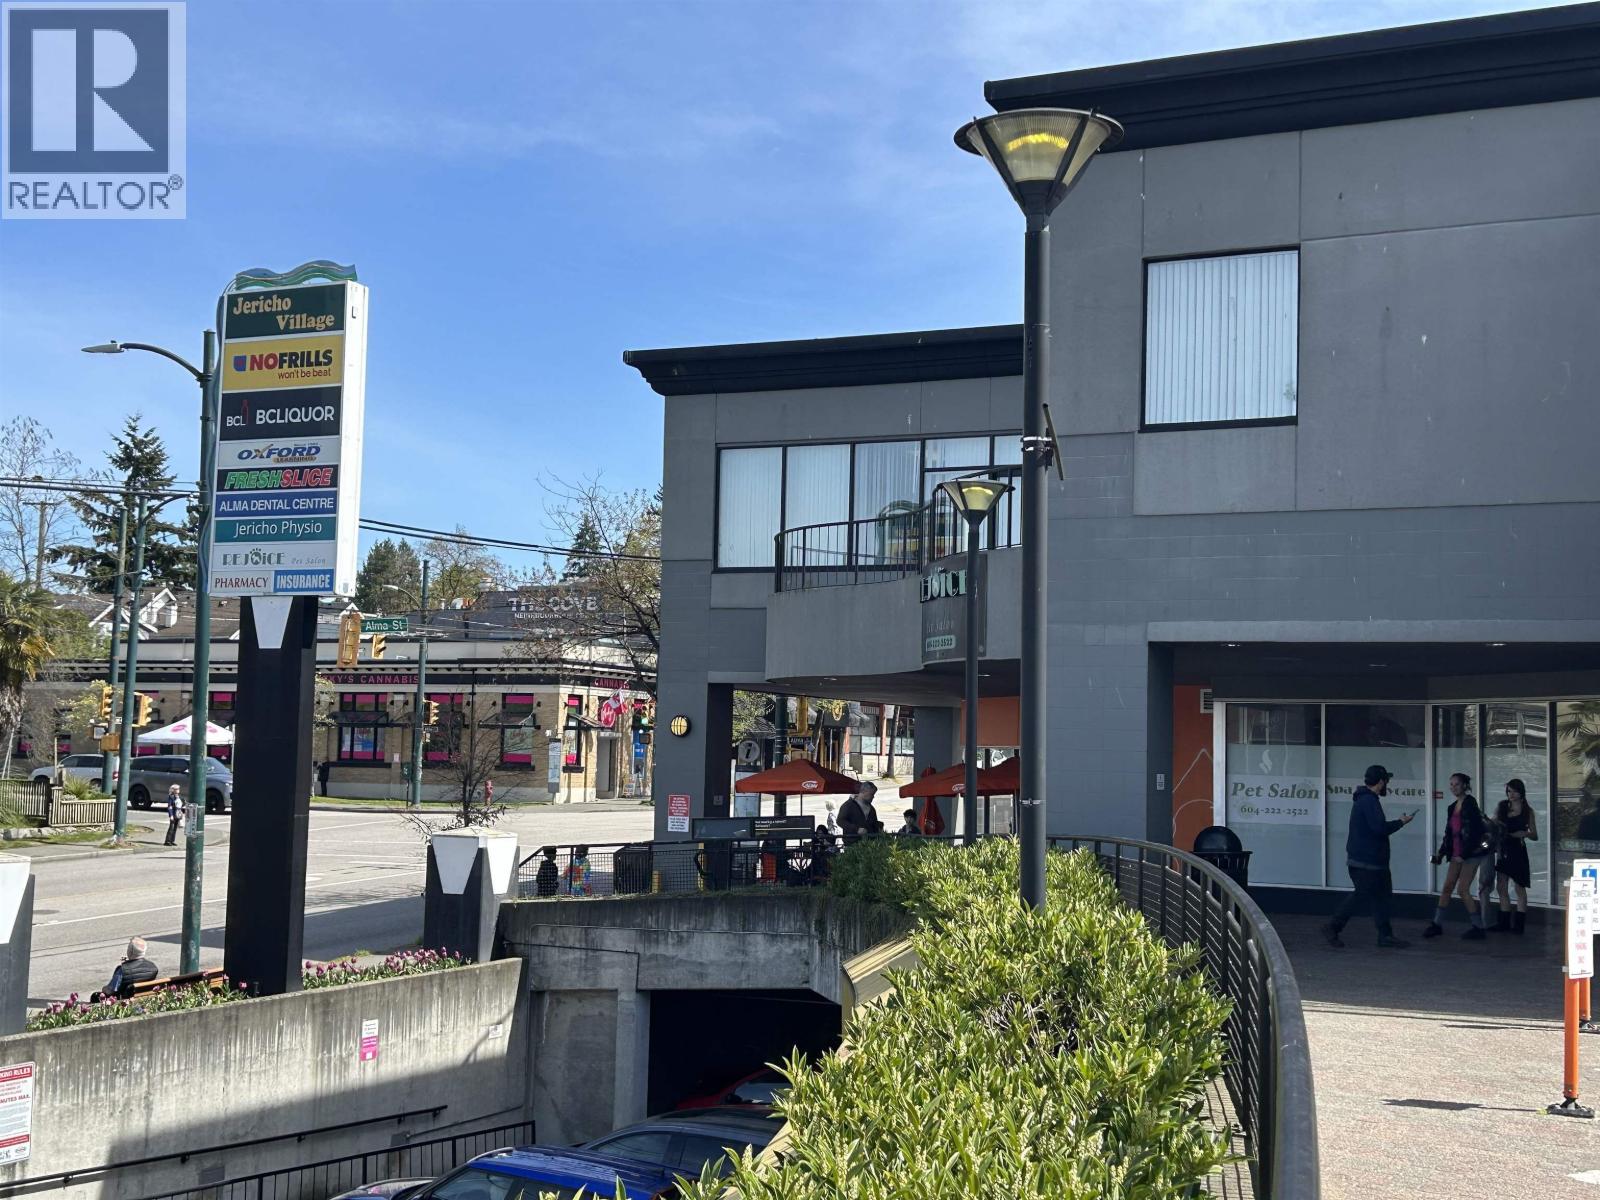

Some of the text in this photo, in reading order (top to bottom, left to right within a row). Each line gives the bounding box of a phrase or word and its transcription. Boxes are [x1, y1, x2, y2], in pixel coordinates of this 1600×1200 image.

[232, 294, 292, 316] Jericho
[275, 312, 336, 331] Village
[277, 367, 332, 380] won't be beat
[226, 415, 247, 427] BCL
[237, 443, 321, 461] OXFORD
[219, 497, 334, 512] ALMA DENTAL CENTRE
[233, 519, 322, 538] Jericho Physio
[214, 574, 330, 589] PHARMACY INSURANCE
[365, 620, 403, 631] Alma St
[360, 674, 419, 684] CANNABIS
[1231, 782, 1264, 798] Pet
[1268, 783, 1319, 800] Salon
[1240, 804, 1309, 817] 604-222-2522
